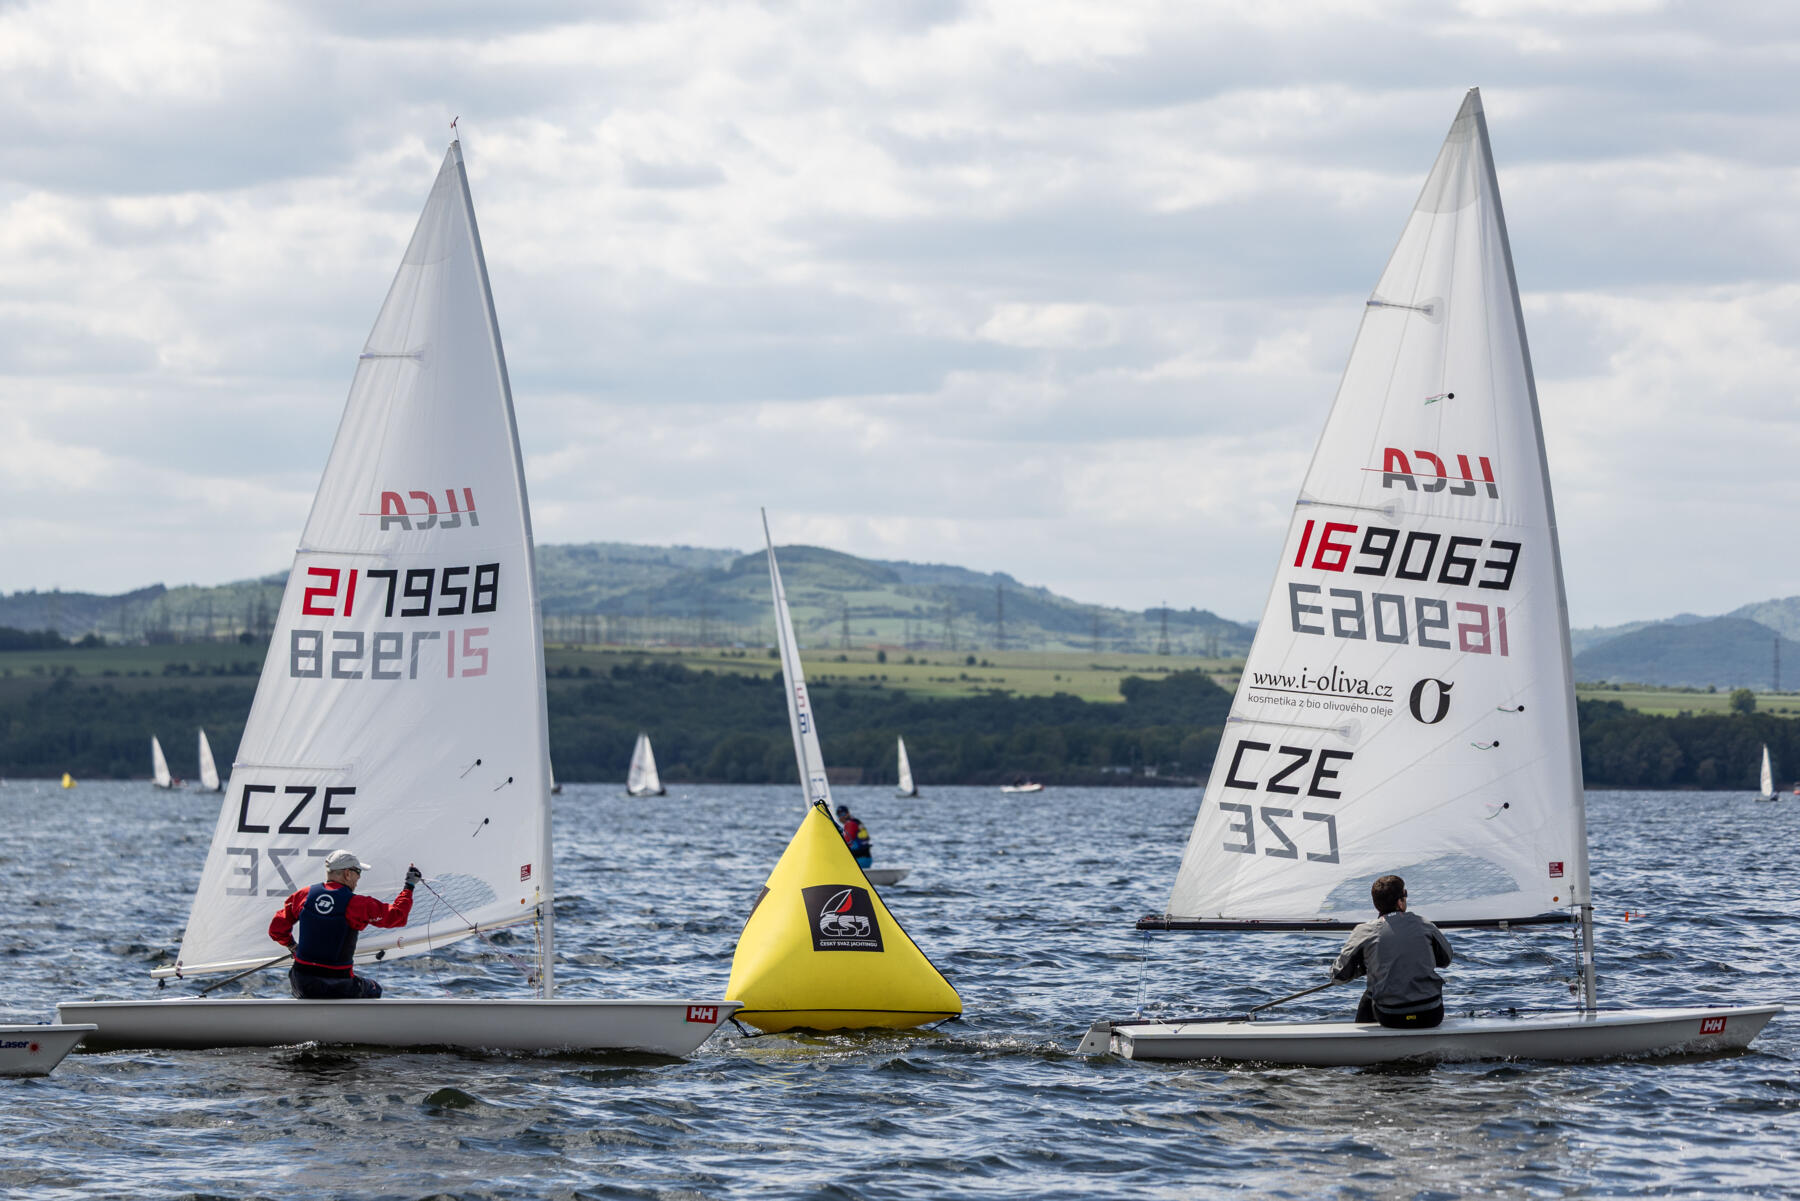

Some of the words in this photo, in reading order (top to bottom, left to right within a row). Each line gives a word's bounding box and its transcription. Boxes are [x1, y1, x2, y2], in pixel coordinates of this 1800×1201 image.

[1293, 519, 1522, 591] 169063
[302, 562, 500, 617] 217958
[1253, 665, 1393, 697] www.i-oliva.cz
[1248, 693, 1296, 707] kosmetika
[1299, 700, 1304, 708] z
[1306, 699, 1320, 709] bio
[1323, 700, 1368, 714] olivového
[1370, 704, 1393, 717] oleje
[1224, 739, 1354, 800] CZE
[237, 784, 356, 835] CZE
[690, 1006, 714, 1020] HH
[1703, 1018, 1723, 1032] HH
[0, 1039, 29, 1049] Laser
